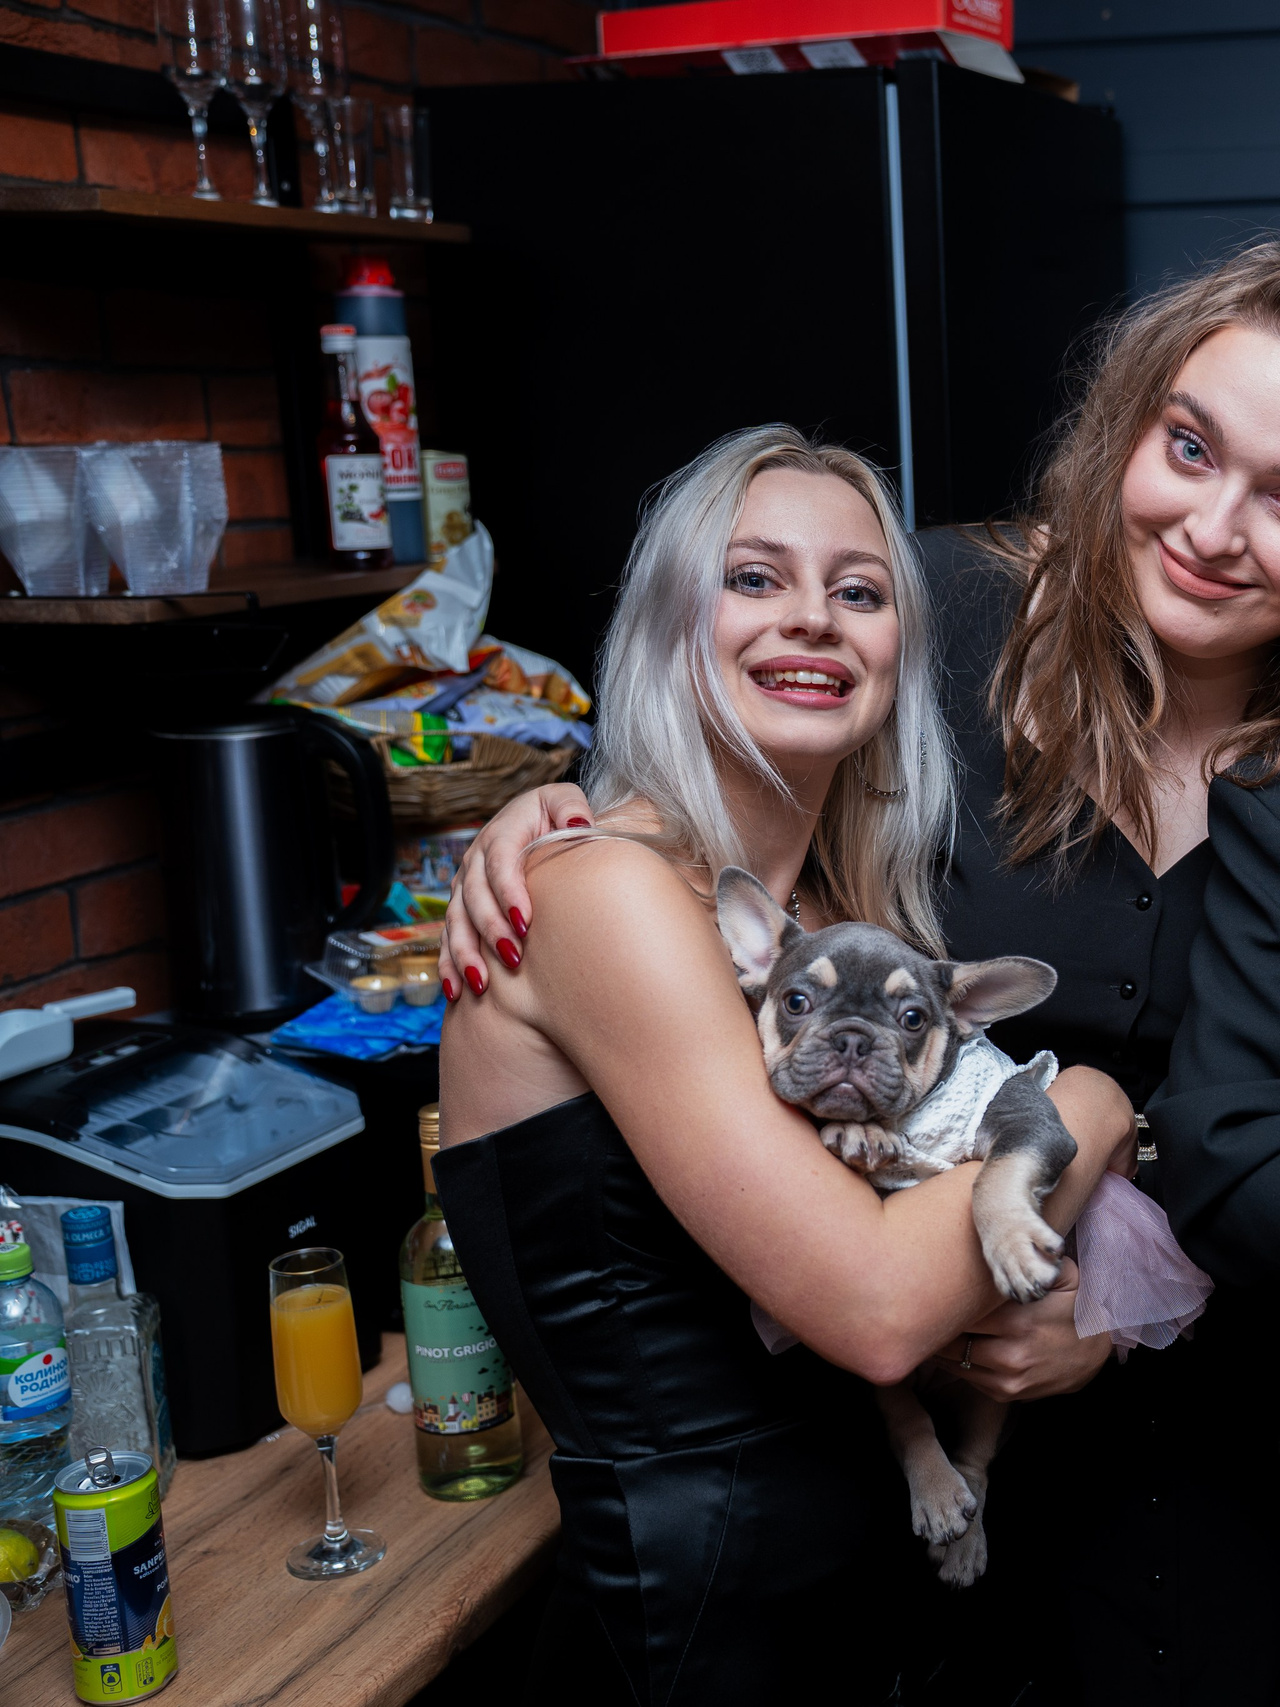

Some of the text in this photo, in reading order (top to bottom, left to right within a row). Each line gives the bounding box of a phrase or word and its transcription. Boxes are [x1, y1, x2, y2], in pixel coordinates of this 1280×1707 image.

[70, 1228, 105, 1242] OLMECA
[415, 1338, 498, 1358] PINOT GRIGIO
